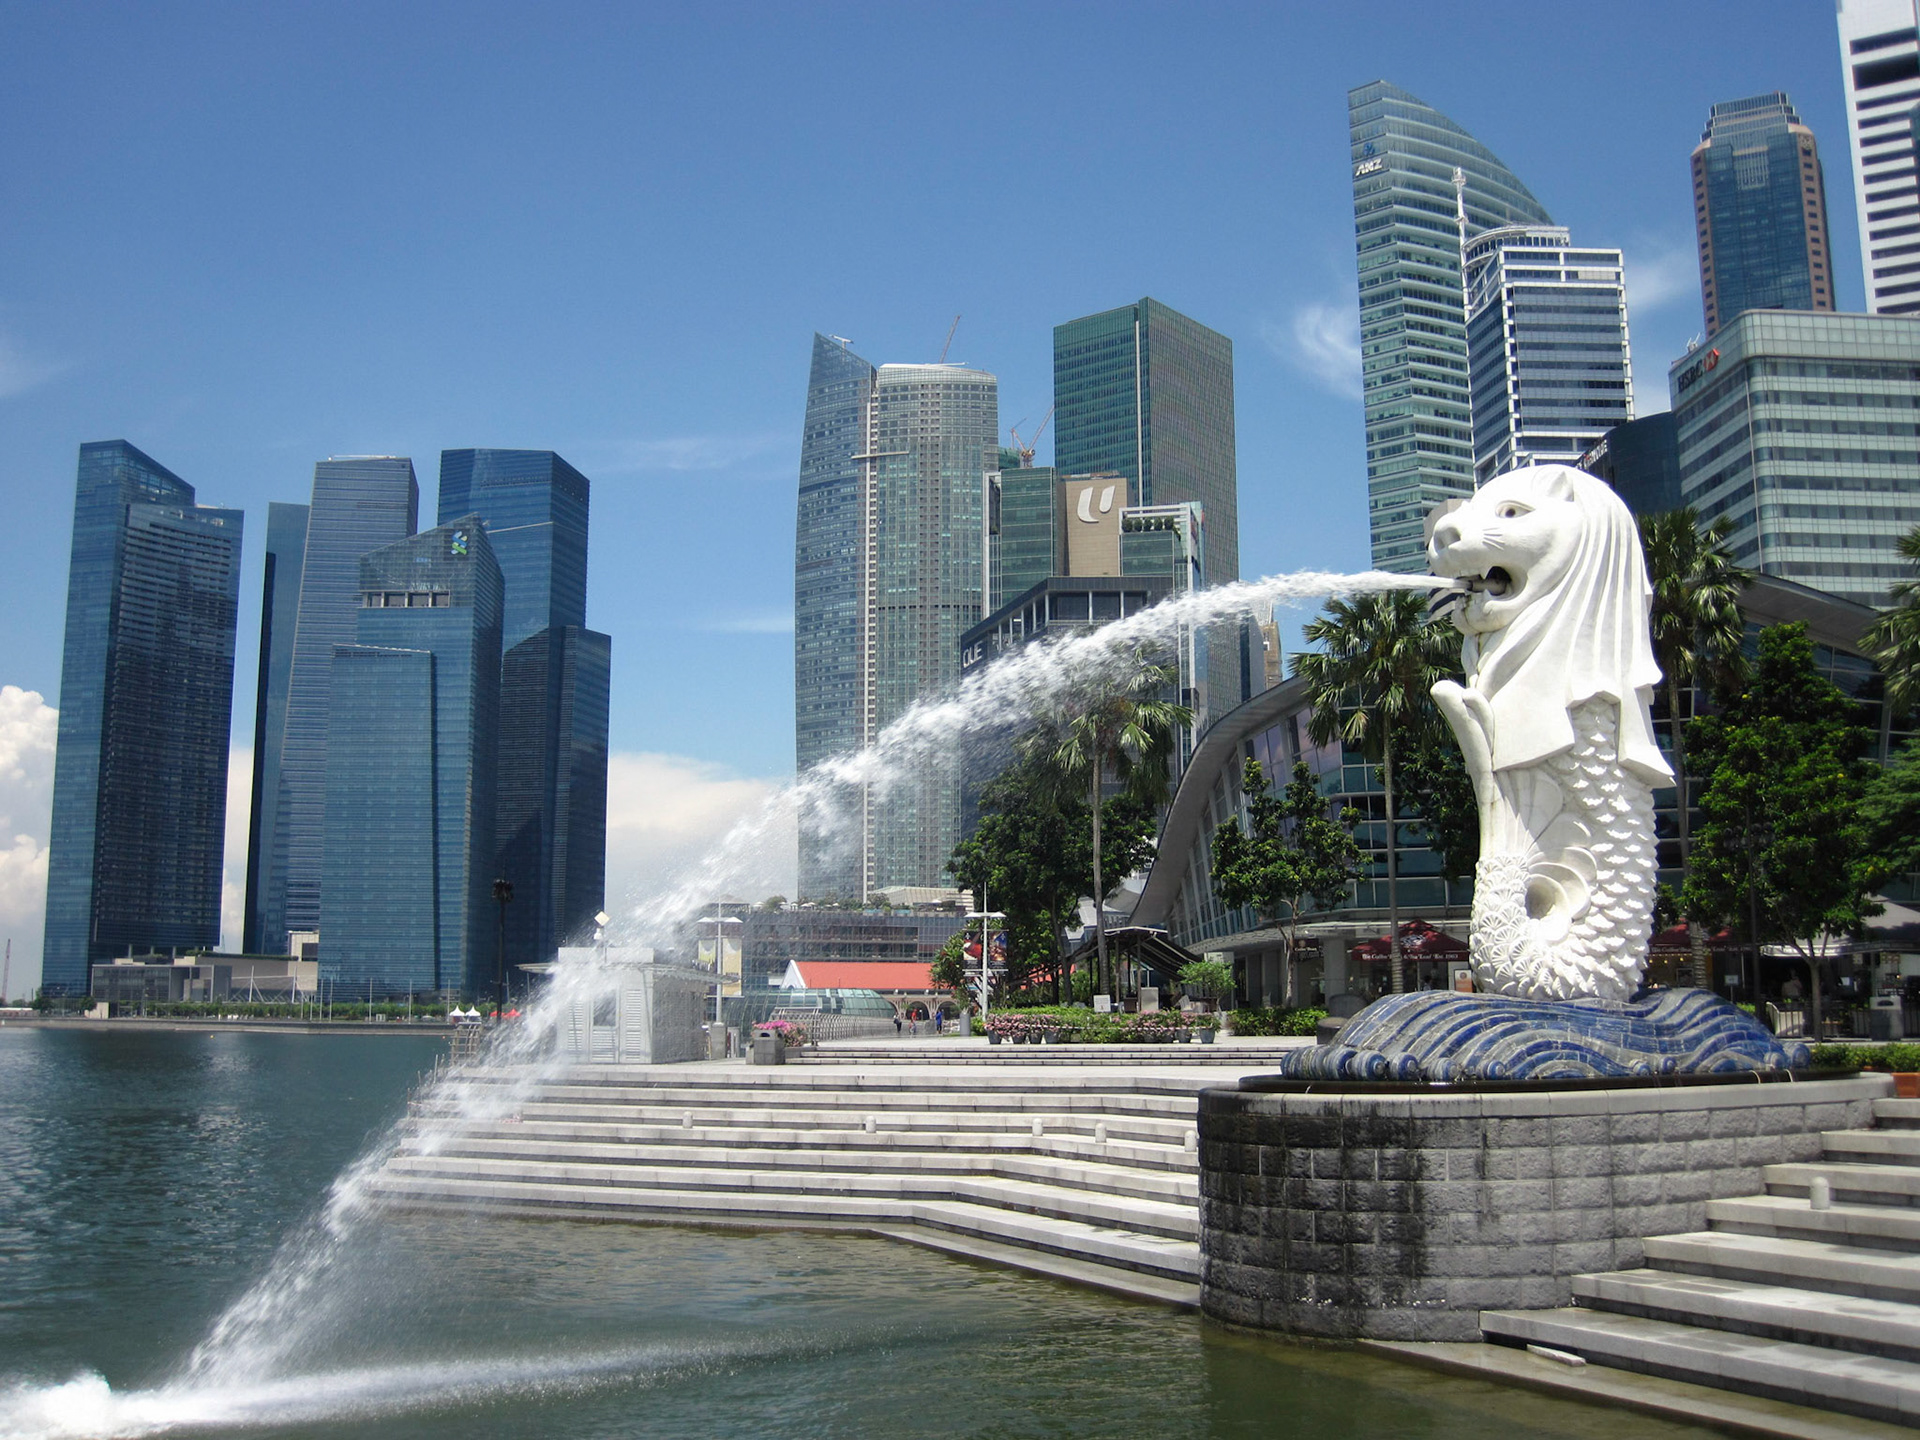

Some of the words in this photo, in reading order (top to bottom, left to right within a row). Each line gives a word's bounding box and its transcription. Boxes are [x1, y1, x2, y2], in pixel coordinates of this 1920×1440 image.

[1355, 158, 1382, 176] ANZ
[1678, 359, 1703, 393] HSBC
[963, 641, 983, 668] OUE
